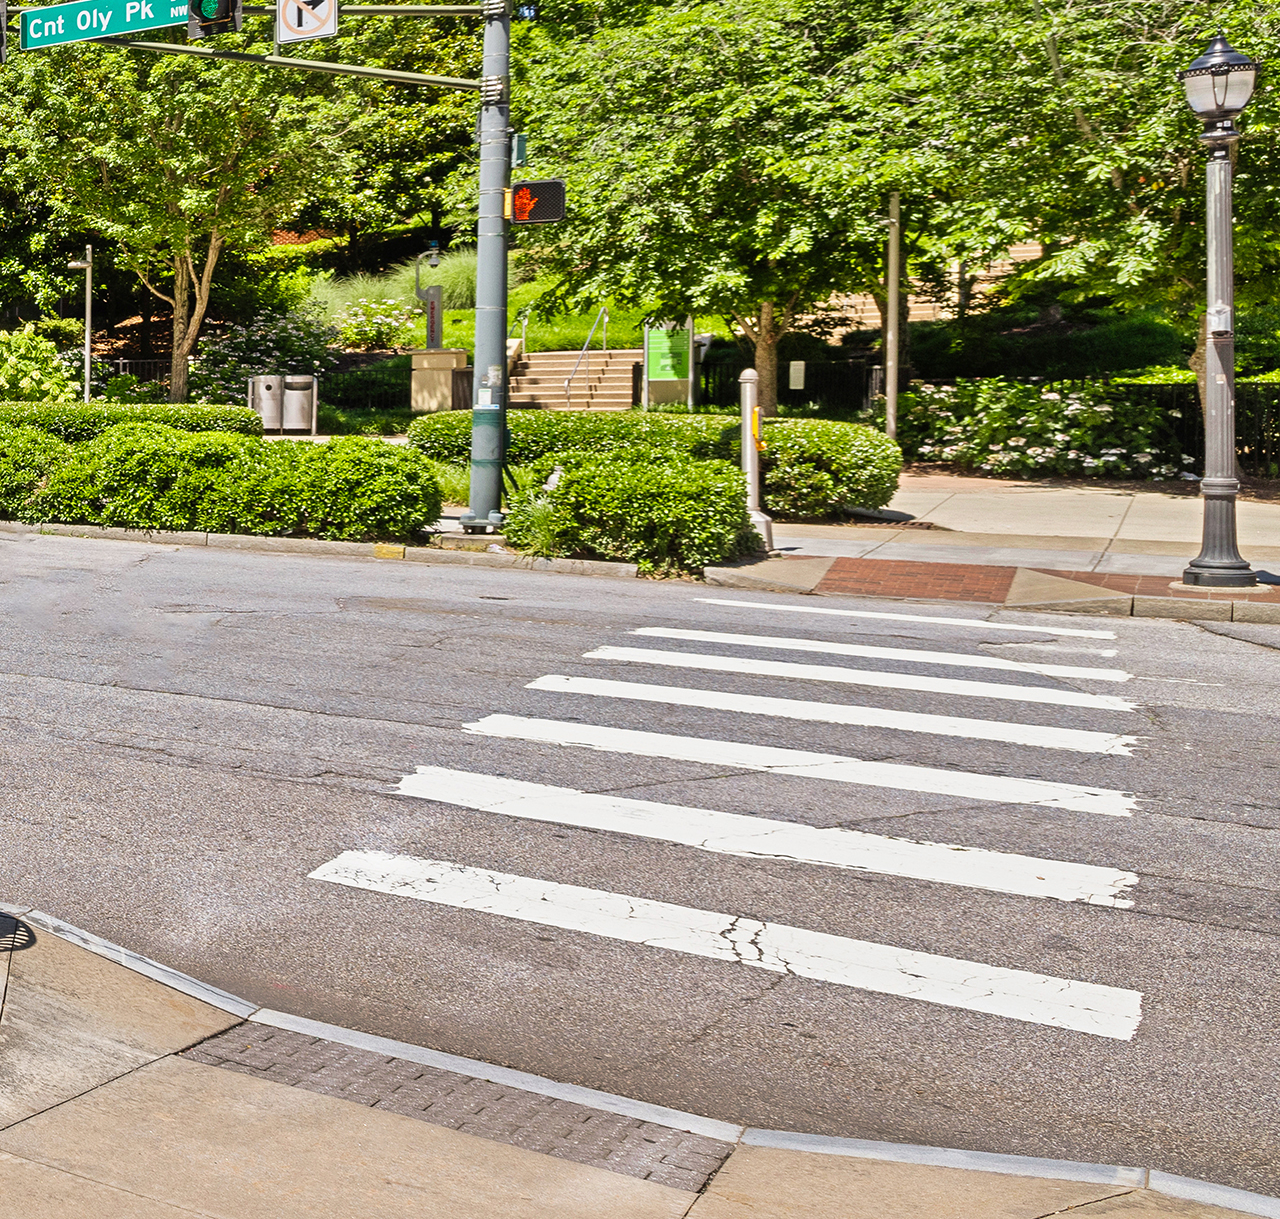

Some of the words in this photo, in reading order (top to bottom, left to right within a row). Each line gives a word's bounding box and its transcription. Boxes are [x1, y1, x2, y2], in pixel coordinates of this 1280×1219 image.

[29, 14, 65, 39] Cnt
[76, 8, 113, 32] Oly
[125, 0, 155, 23] Pk
[170, 4, 188, 18] NW
